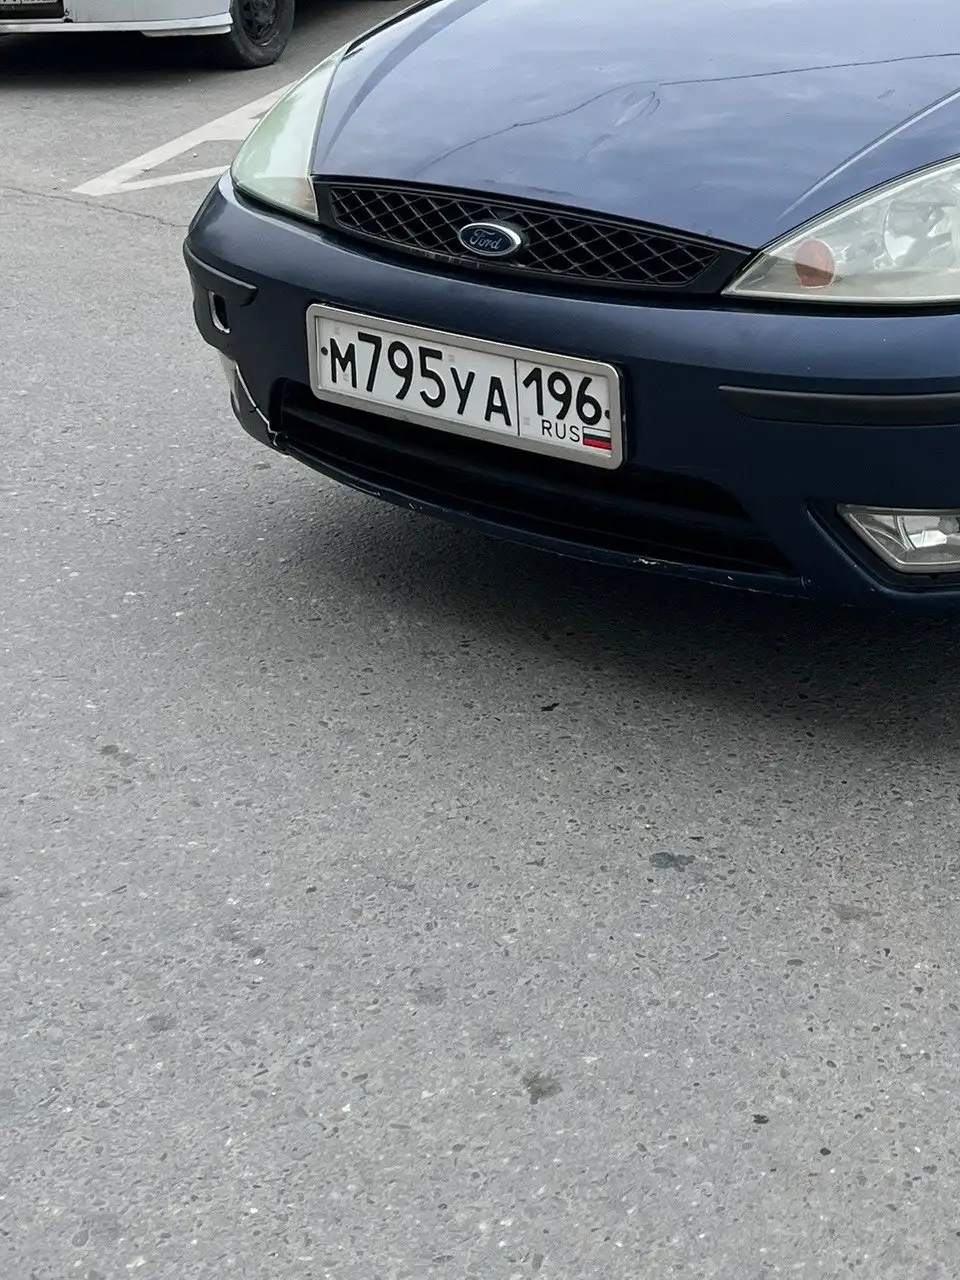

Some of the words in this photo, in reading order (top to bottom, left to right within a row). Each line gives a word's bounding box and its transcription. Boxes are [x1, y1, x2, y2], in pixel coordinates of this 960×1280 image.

[469, 229, 503, 250] Ford
[329, 331, 512, 427] М795УА
[522, 367, 603, 426] 196
[541, 419, 581, 444] RUS
